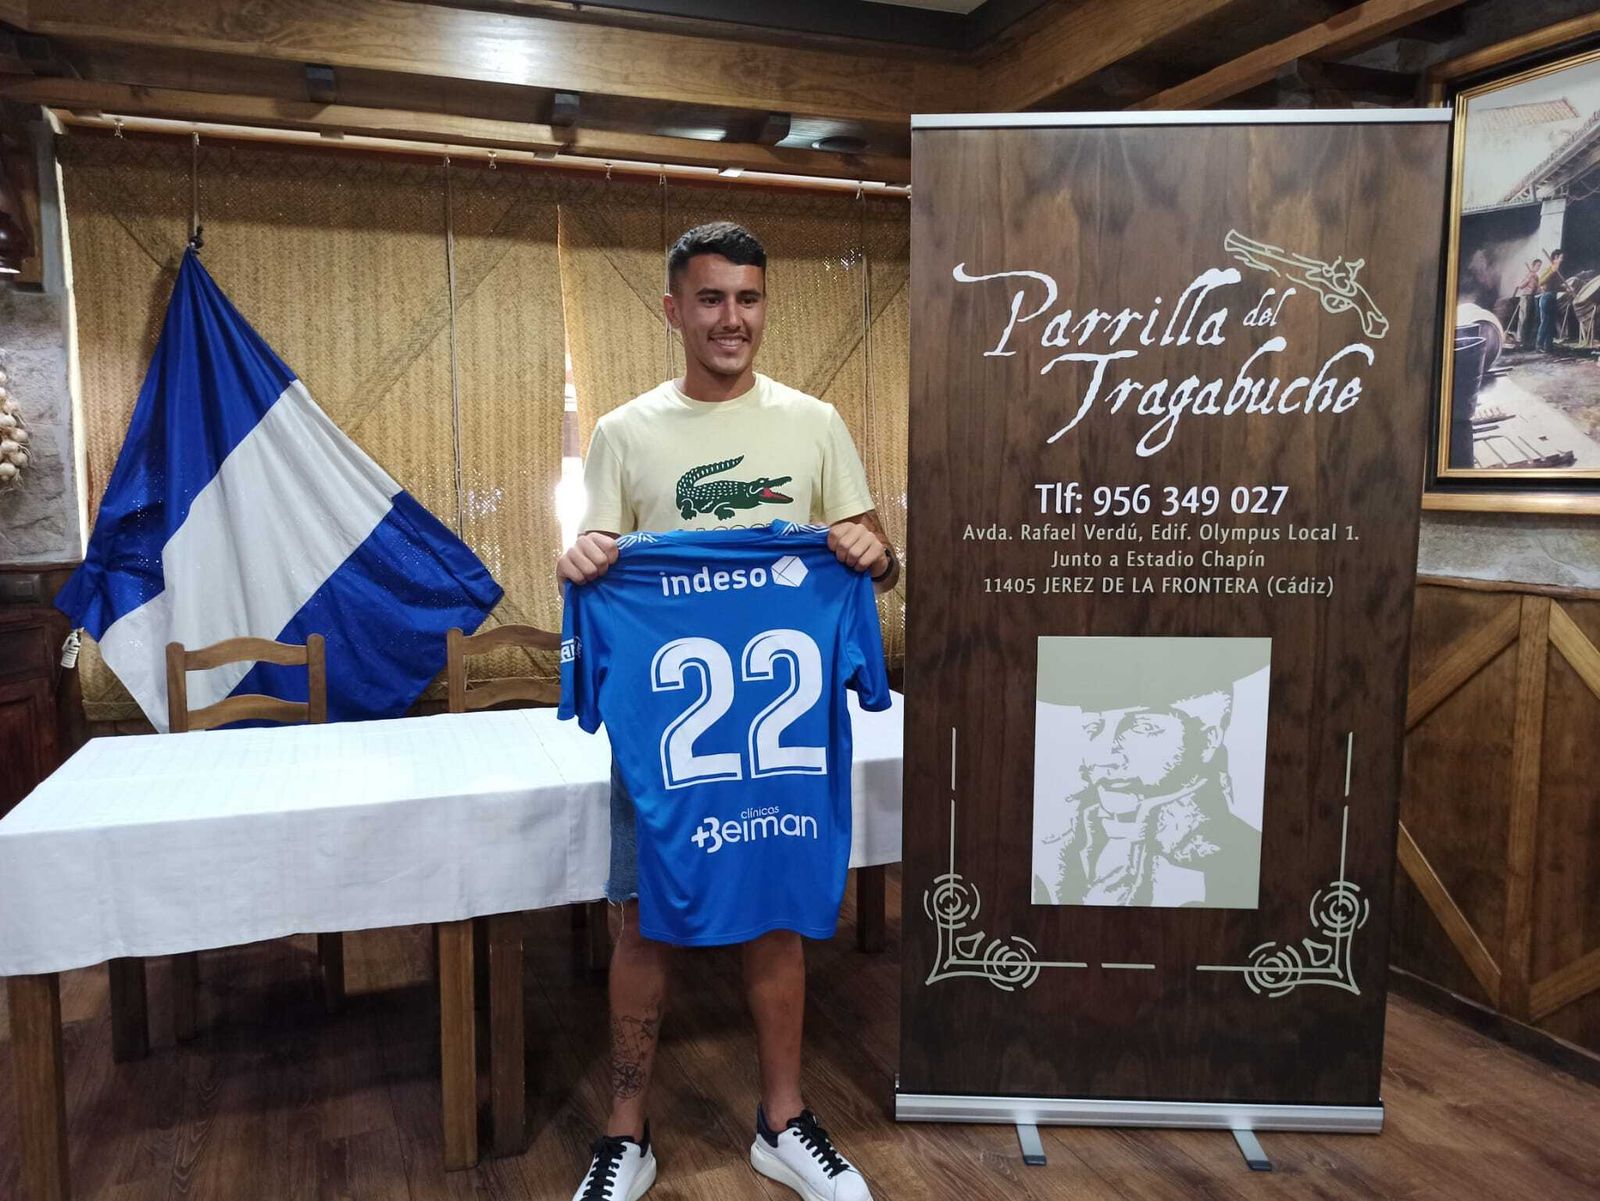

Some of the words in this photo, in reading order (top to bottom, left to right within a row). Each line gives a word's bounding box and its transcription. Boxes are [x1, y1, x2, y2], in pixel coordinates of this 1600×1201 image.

[952, 262, 1241, 357] Parrilla
[1242, 287, 1296, 329] del
[1040, 336, 1374, 457] Tragabuche
[1034, 482, 1083, 514] Tlf:
[1093, 484, 1151, 516] 956
[1161, 486, 1220, 516] 349
[1230, 486, 1289, 515] 027
[963, 523, 1013, 541] Avda.
[1020, 523, 1076, 541] Rafael
[1084, 522, 1143, 542] Verdú,
[1151, 523, 1191, 541] Edif.
[1200, 523, 1280, 544] Olympus
[1288, 523, 1337, 541] Local
[1345, 525, 1360, 541] 1.
[1051, 551, 1102, 568] Junto
[1109, 554, 1119, 567] a
[1127, 550, 1194, 567] Estadio
[1202, 550, 1265, 571] Chapín
[659, 566, 767, 597] indeso
[984, 577, 1036, 594] 11405
[1043, 577, 1094, 594] JEREZ
[1102, 577, 1124, 593] DE
[1132, 577, 1154, 593] LA
[1162, 577, 1259, 594] FRONTERA
[1267, 576, 1334, 598] (Cádiz)
[651, 628, 828, 790] 22
[740, 805, 780, 820] clínicas
